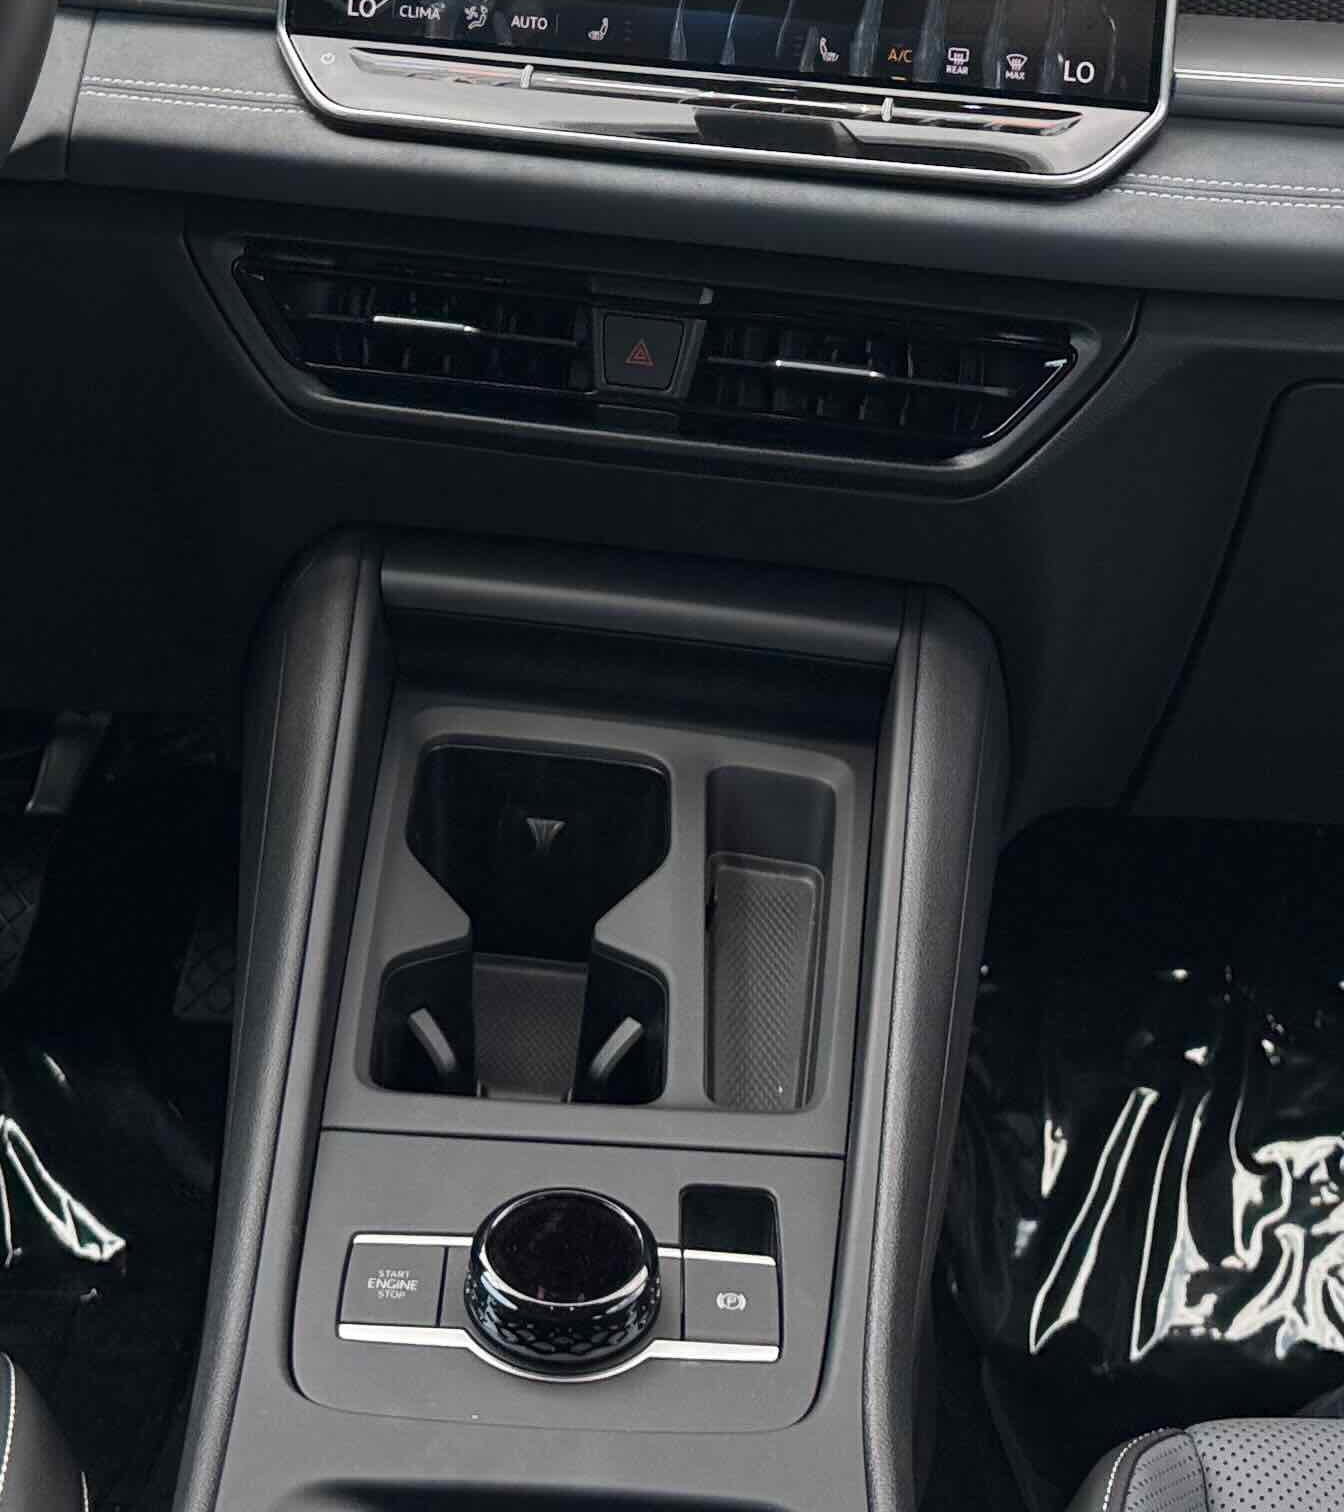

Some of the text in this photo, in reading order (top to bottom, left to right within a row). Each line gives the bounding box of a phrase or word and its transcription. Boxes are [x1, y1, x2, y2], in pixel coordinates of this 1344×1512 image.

[399, 4, 441, 20] CLIMA
[511, 15, 548, 30] AUTO
[887, 51, 913, 64] A/C
[946, 65, 969, 75] REAR
[1006, 71, 1025, 81] MAX
[1063, 60, 1095, 84] LO
[378, 1270, 409, 1279] START
[367, 1278, 419, 1292] ENGINE
[377, 1290, 406, 1299] STOP
